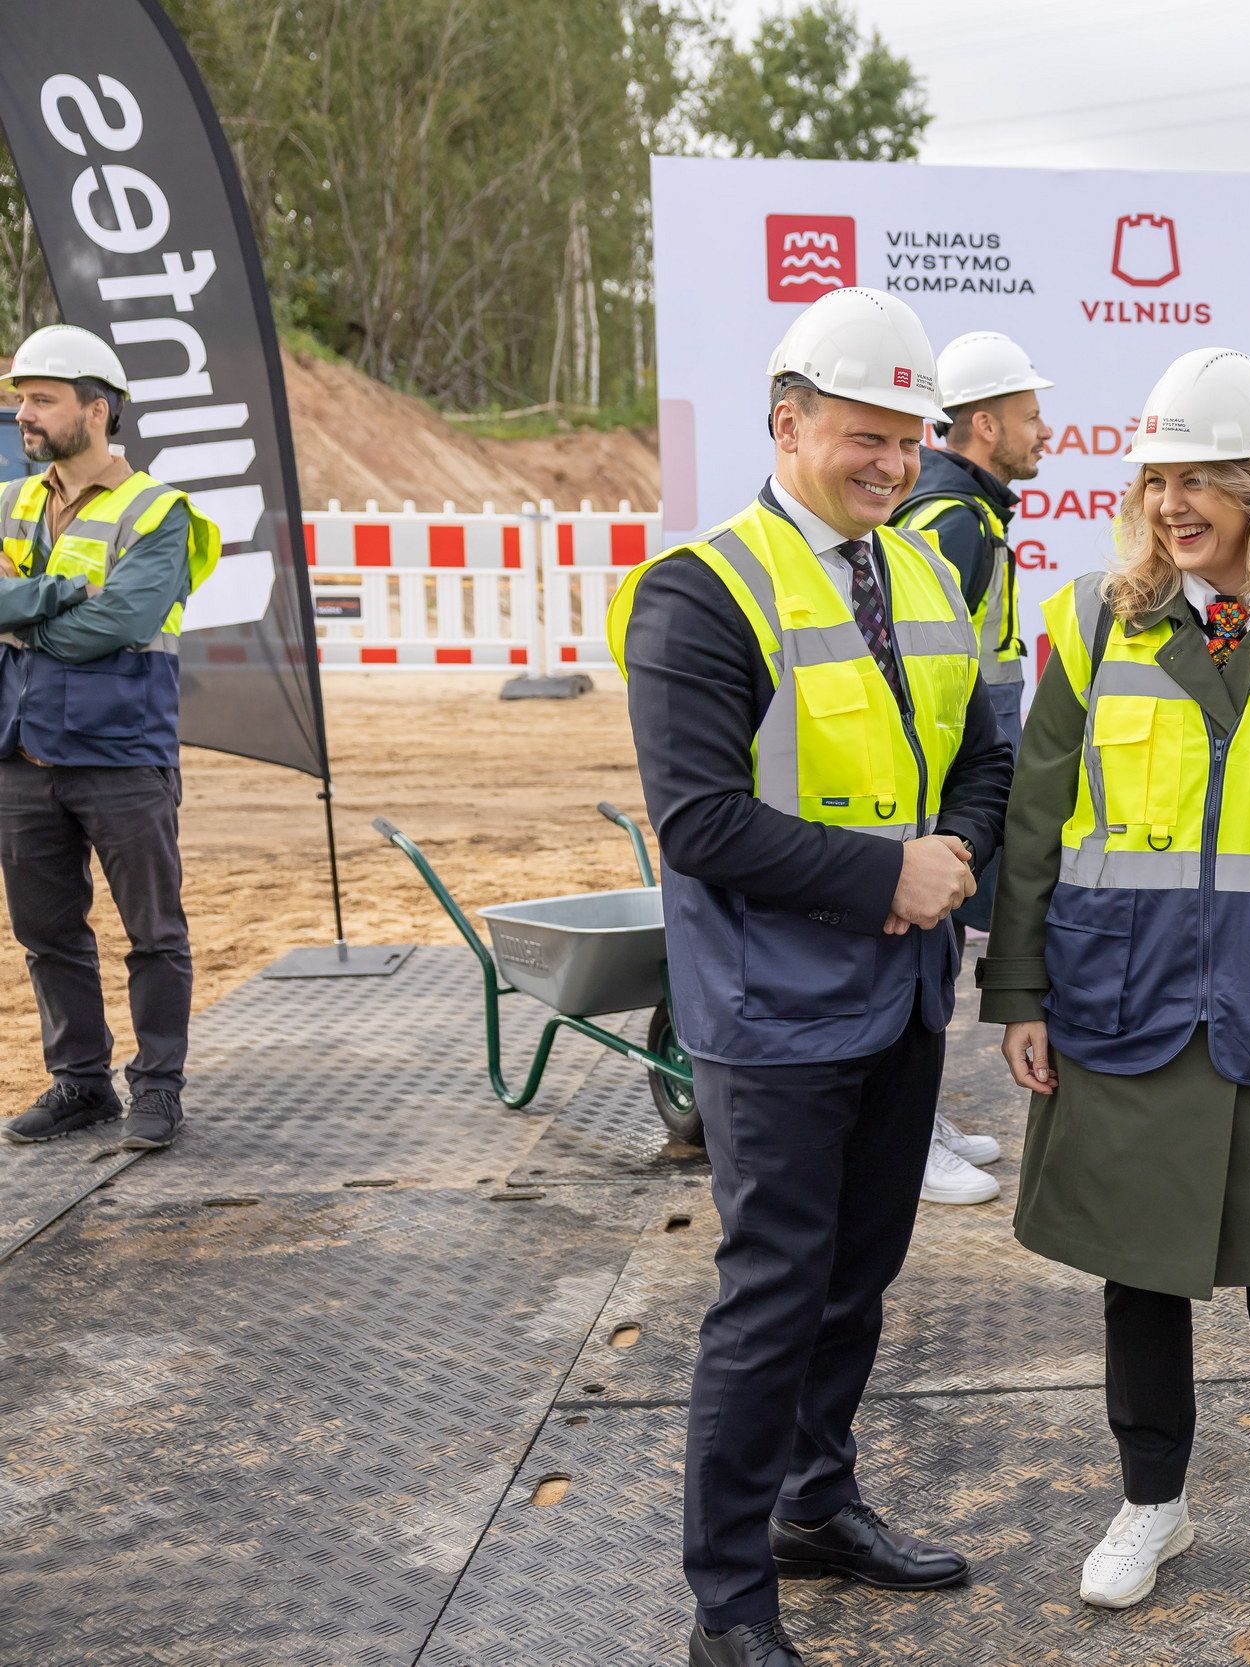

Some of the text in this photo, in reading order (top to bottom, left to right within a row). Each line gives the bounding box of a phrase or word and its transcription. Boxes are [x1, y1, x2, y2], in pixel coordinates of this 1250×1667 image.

[886, 231, 1001, 249] VILNIAUS
[887, 254, 1012, 272] VYSTYMO
[886, 276, 1036, 296] KOMPANIJA
[1081, 300, 1213, 325] VILNIUS
